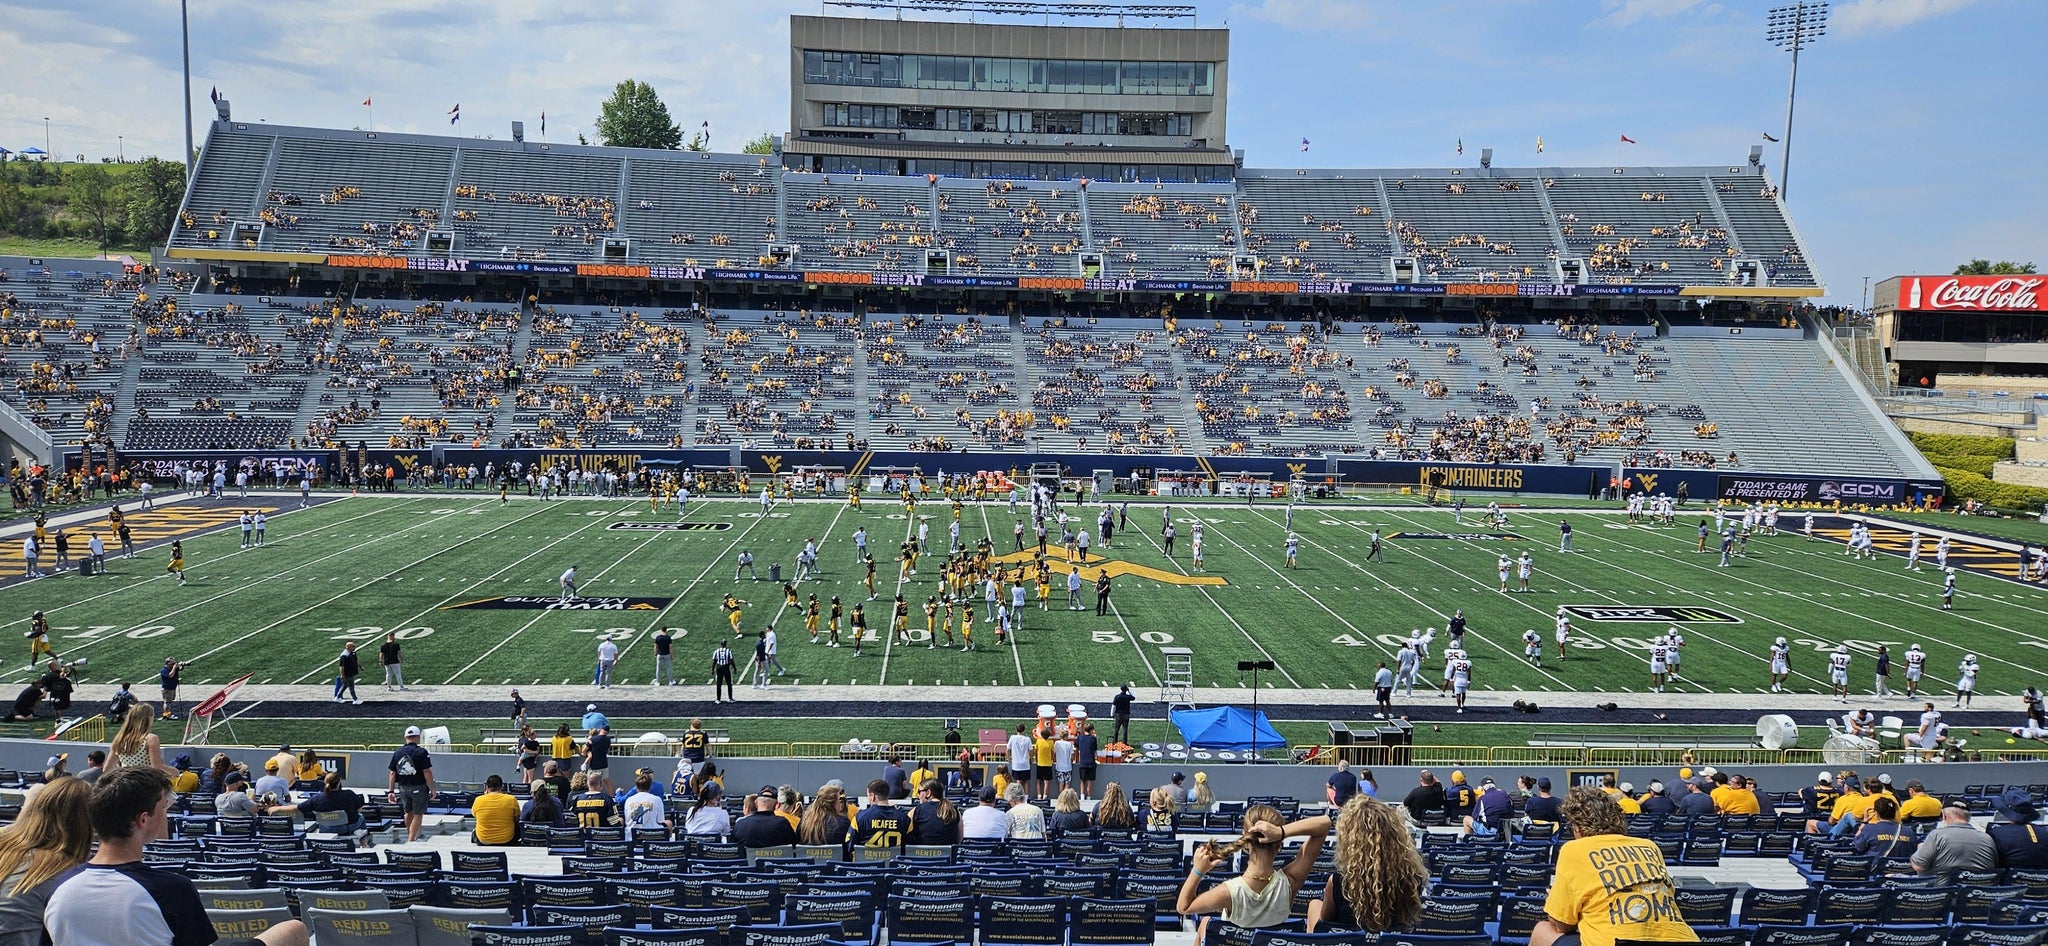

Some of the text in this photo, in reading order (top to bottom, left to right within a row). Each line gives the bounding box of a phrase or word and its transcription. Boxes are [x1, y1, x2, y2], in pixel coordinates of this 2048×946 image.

[359, 257, 407, 268] GOOD
[446, 260, 469, 271] AT
[606, 266, 650, 277] GOOD
[684, 268, 705, 279] AT
[832, 273, 872, 284] GOOD
[904, 275, 924, 285] AT
[1045, 279, 1084, 289] GOOD
[1116, 280, 1136, 290] AT
[1258, 282, 1298, 292] GOOD
[1331, 283, 1352, 293] AT
[1475, 284, 1518, 295] GOOD
[1553, 284, 1575, 295] AT
[1931, 279, 2044, 308] Coca-Cola
[1733, 481, 1809, 491] TODAY'S GAME
[1840, 483, 1894, 495] GCM
[1725, 488, 1808, 499] IS PRESENTED BY
[1091, 631, 1174, 643] 50
[1331, 634, 1411, 647] 40
[1565, 637, 1651, 649] 30
[1448, 652, 1459, 661] 25
[1654, 649, 1665, 658] 22
[1835, 656, 1845, 665] 17
[1456, 662, 1468, 672] 28
[685, 734, 703, 748] 23
[673, 783, 685, 795] 30
[1459, 789, 1469, 806] 5
[871, 819, 898, 829] MCAFEE
[865, 830, 901, 848] 40
[755, 849, 783, 857] RENTED
[806, 849, 834, 857] RENTED
[864, 850, 891, 858] RENTED
[915, 849, 942, 857] RENTED
[1589, 845, 1661, 870] COUNTRY
[981, 879, 1022, 887] Panhandle
[1137, 883, 1178, 891] Panhandle
[462, 887, 510, 895] Panhandle
[547, 886, 594, 894] Panhandle
[629, 888, 675, 897] Panhandle
[723, 889, 769, 897] Panhandle
[915, 889, 960, 897] Panhandle
[213, 899, 264, 910] RENTED
[314, 898, 366, 909] RENTED
[810, 900, 861, 909] Panhandle
[912, 903, 964, 911] Panhandle
[1003, 903, 1056, 912] Panhandle
[562, 914, 622, 922] Panhandle
[332, 920, 390, 931] RENTED
[502, 934, 572, 944] Panhandle
[763, 933, 830, 943] Panhandle
[1884, 932, 1941, 941] Panhandle
[637, 938, 705, 946] Panhandle
